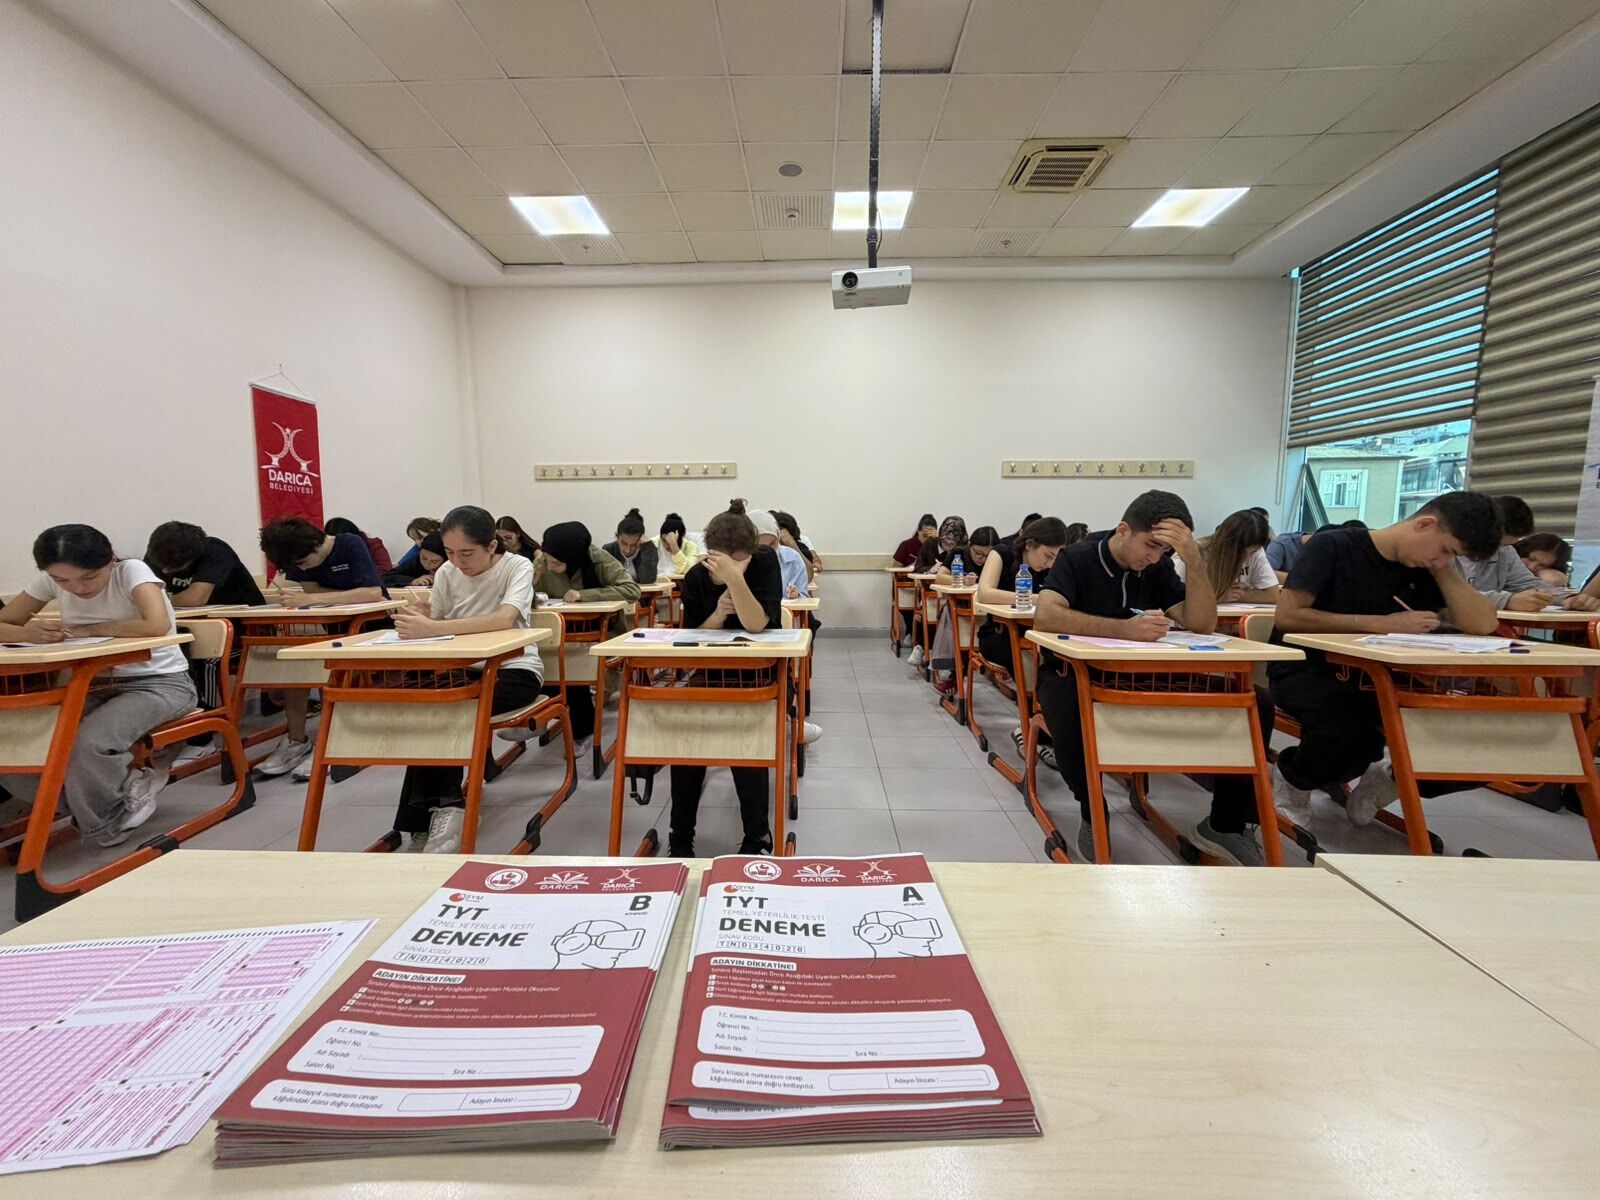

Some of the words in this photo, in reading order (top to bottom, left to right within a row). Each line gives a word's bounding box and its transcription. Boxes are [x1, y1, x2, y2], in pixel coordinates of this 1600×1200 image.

[268, 469, 312, 487] DARICA
[902, 886, 924, 902] A
[629, 895, 652, 911] B
[722, 896, 769, 909] TYT
[437, 904, 489, 921] TYT
[428, 919, 456, 928] TEMEL
[719, 918, 827, 937] DENEME
[410, 927, 529, 947] DENEME
[375, 970, 410, 979] ADAYIN
[717, 1022, 740, 1030] Öğrenci
[764, 1080, 782, 1088] doğru
